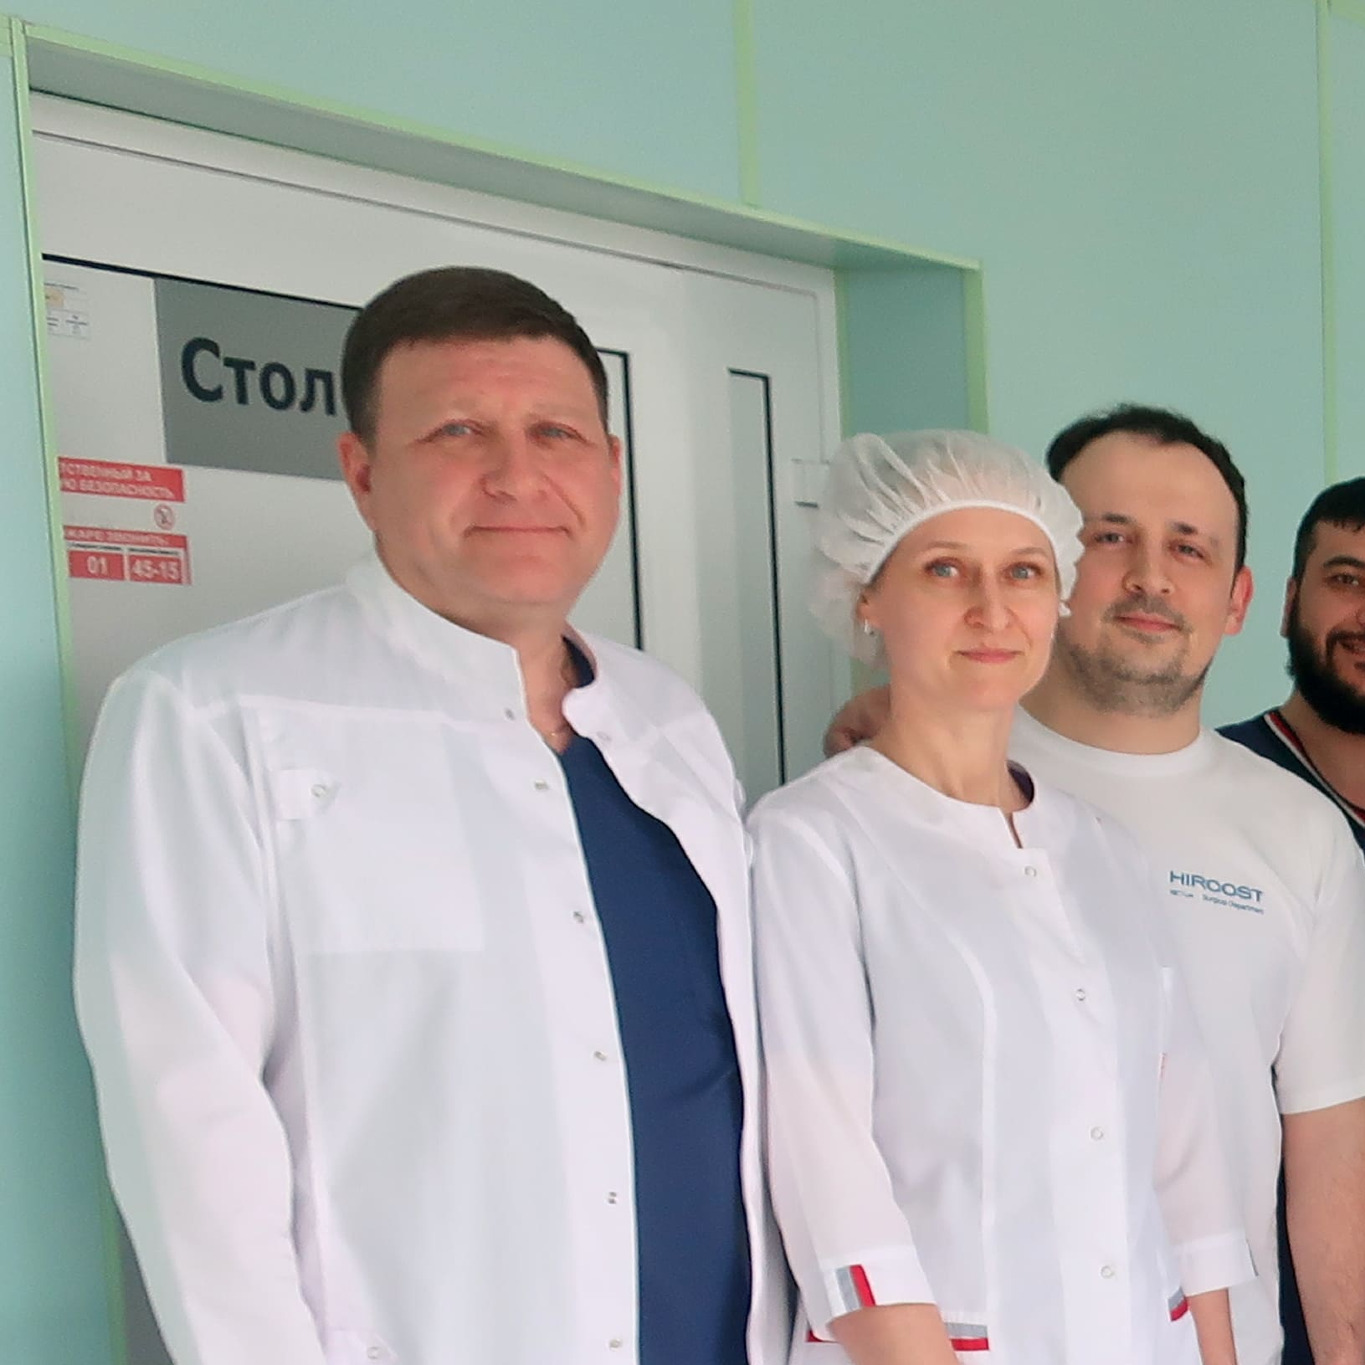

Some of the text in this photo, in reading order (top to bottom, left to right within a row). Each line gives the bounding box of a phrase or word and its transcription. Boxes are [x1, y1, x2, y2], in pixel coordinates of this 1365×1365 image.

[86, 555, 109, 575] 01
[131, 558, 179, 579] 45-15
[1170, 870, 1263, 902] HIROOST
